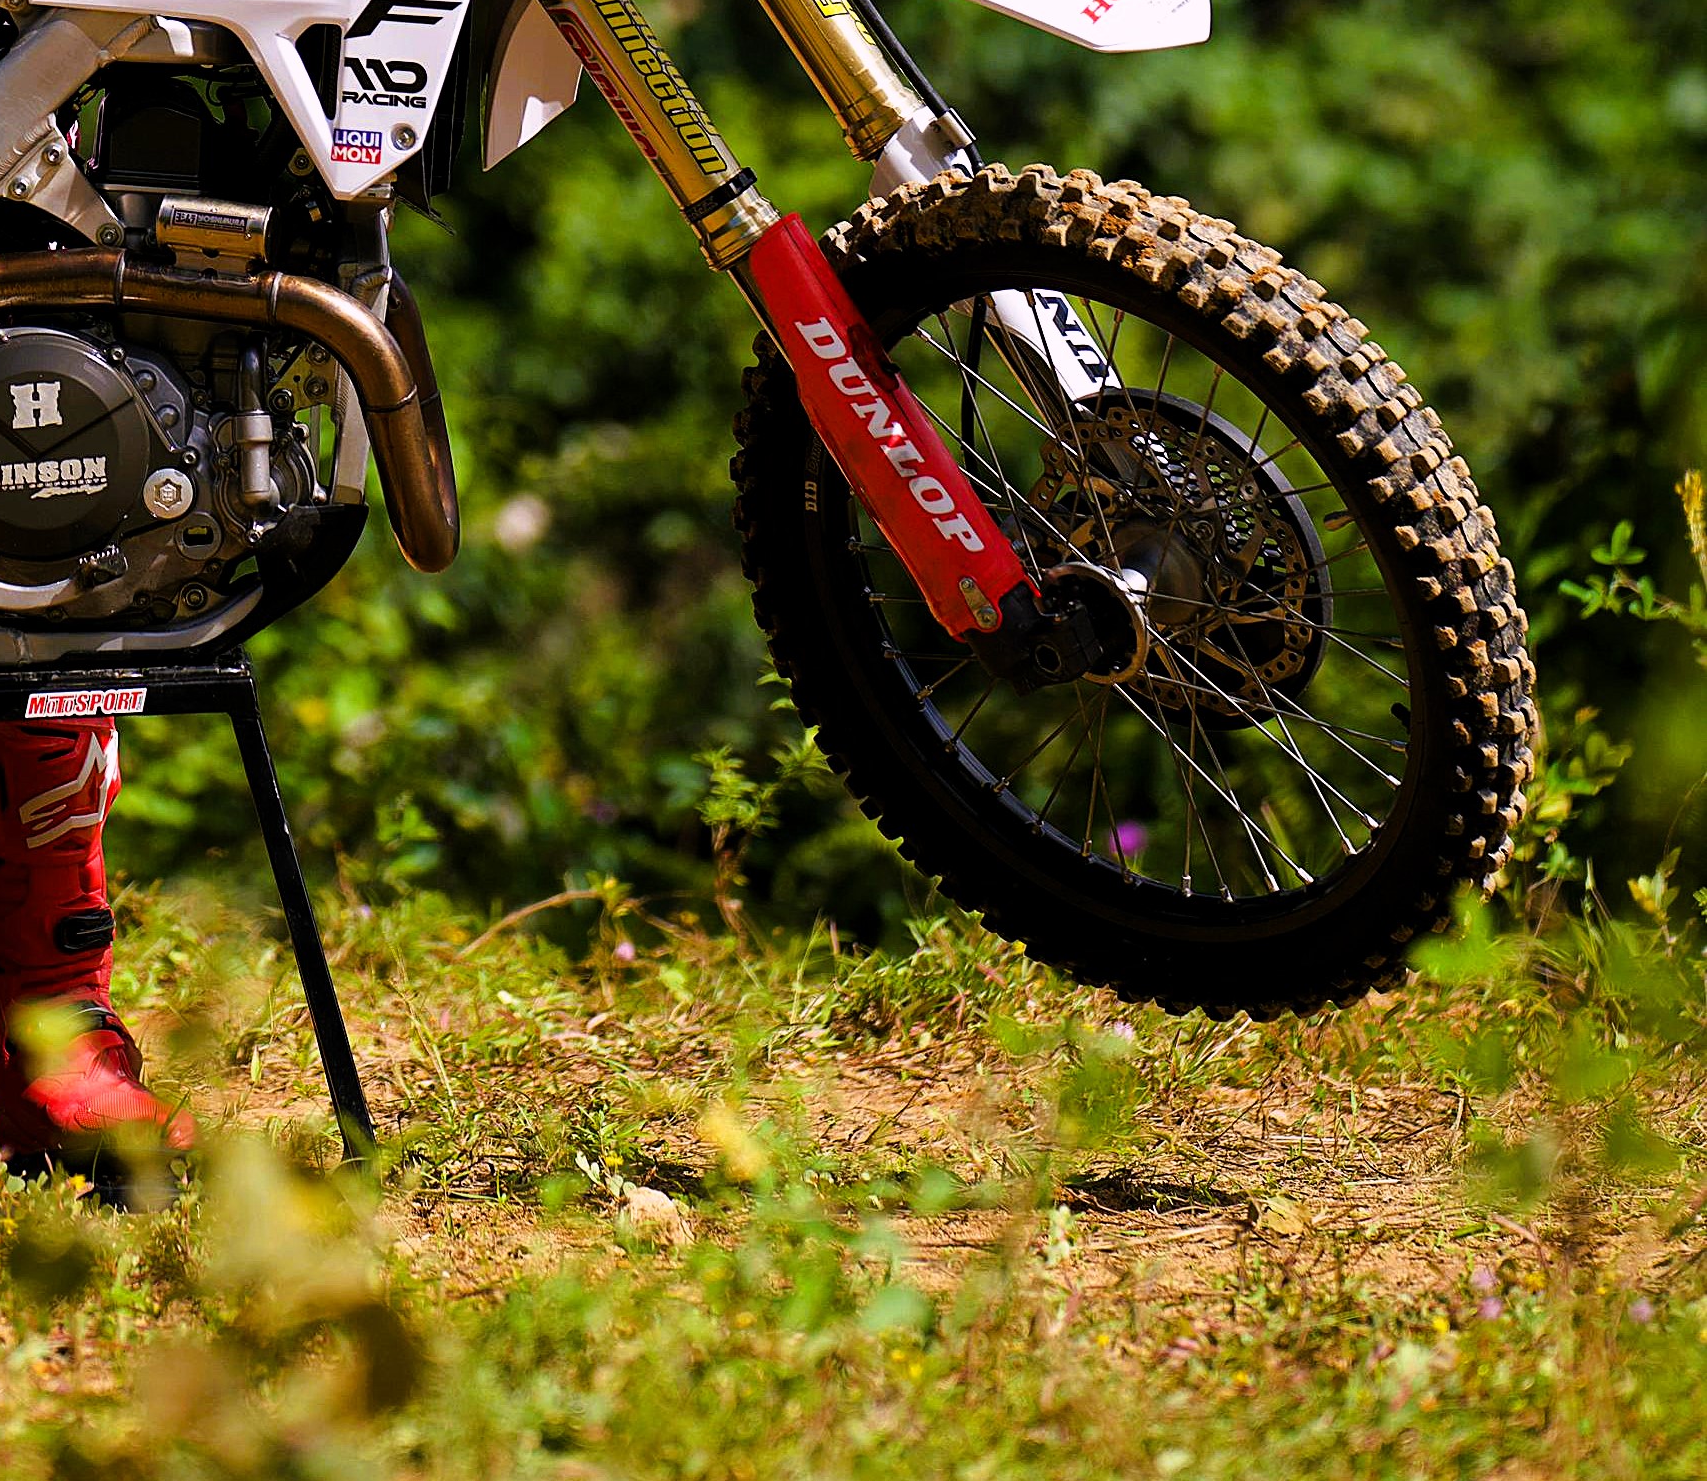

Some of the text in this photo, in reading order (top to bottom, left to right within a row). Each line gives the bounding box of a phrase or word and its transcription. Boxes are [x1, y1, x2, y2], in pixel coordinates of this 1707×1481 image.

[344, 57, 427, 94] 110
[342, 91, 426, 109] RACING
[335, 130, 380, 147] LIQUI
[332, 146, 380, 163] MOLY
[794, 317, 985, 552] DUNLOP
